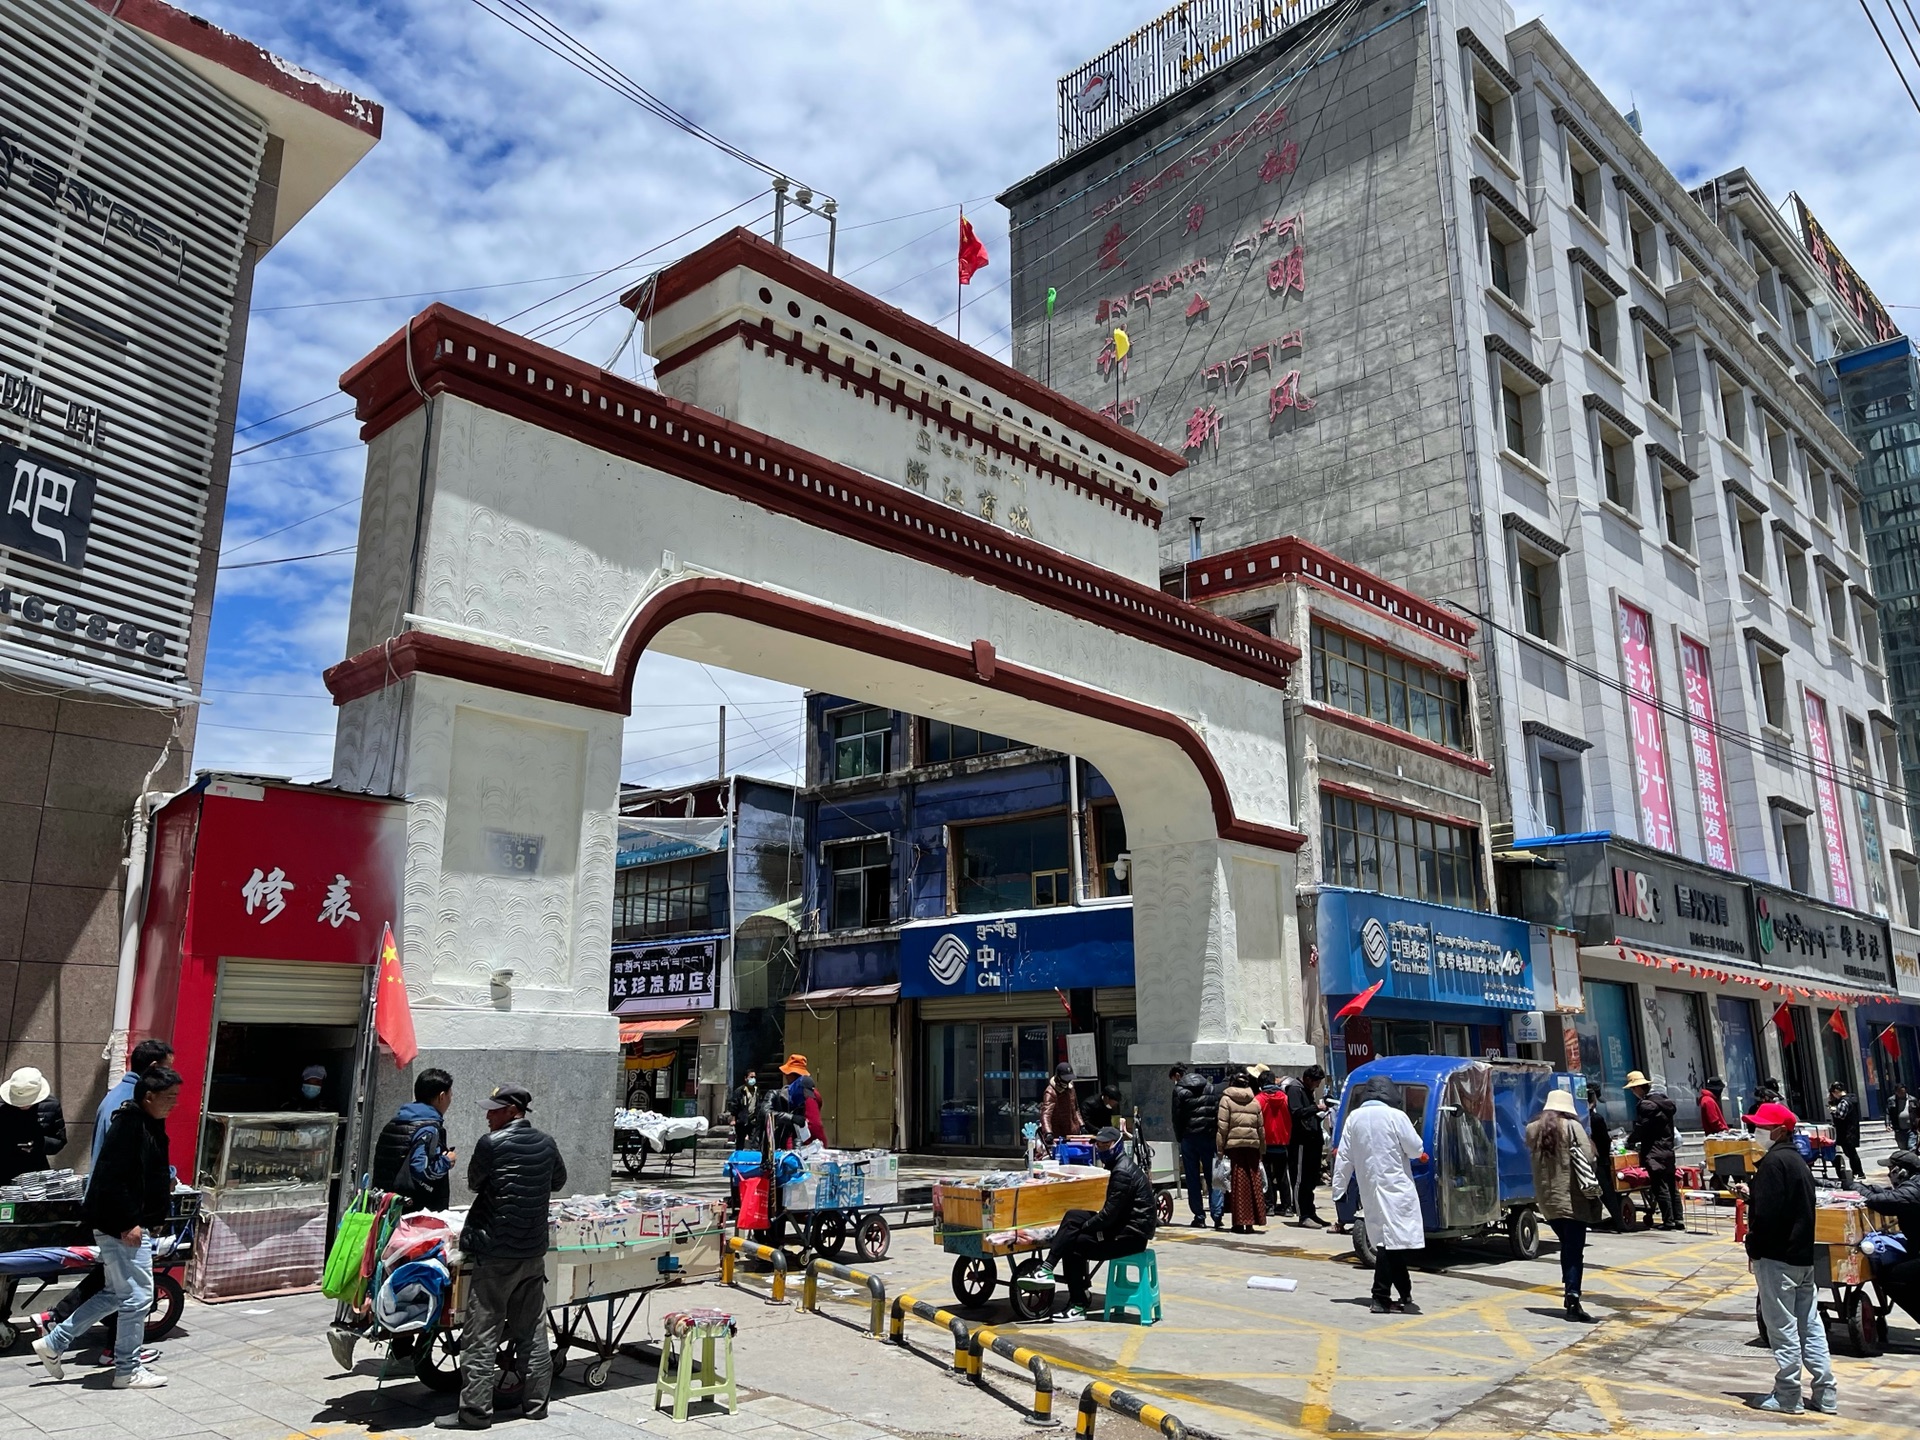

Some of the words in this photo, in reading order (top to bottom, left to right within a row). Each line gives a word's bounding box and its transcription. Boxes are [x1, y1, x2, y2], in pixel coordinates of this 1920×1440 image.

[8, 458, 77, 562] 吧
[242, 866, 361, 928] 修表
[1391, 938, 1431, 961] 中国移动
[1391, 960, 1412, 974] China
[1437, 952, 1502, 976] 宽带电视服务中心
[1502, 950, 1522, 976] 4G
[613, 971, 705, 997] 达珍凉粉店
[977, 972, 1001, 987] Chi
[1347, 1043, 1368, 1056] VIVO
